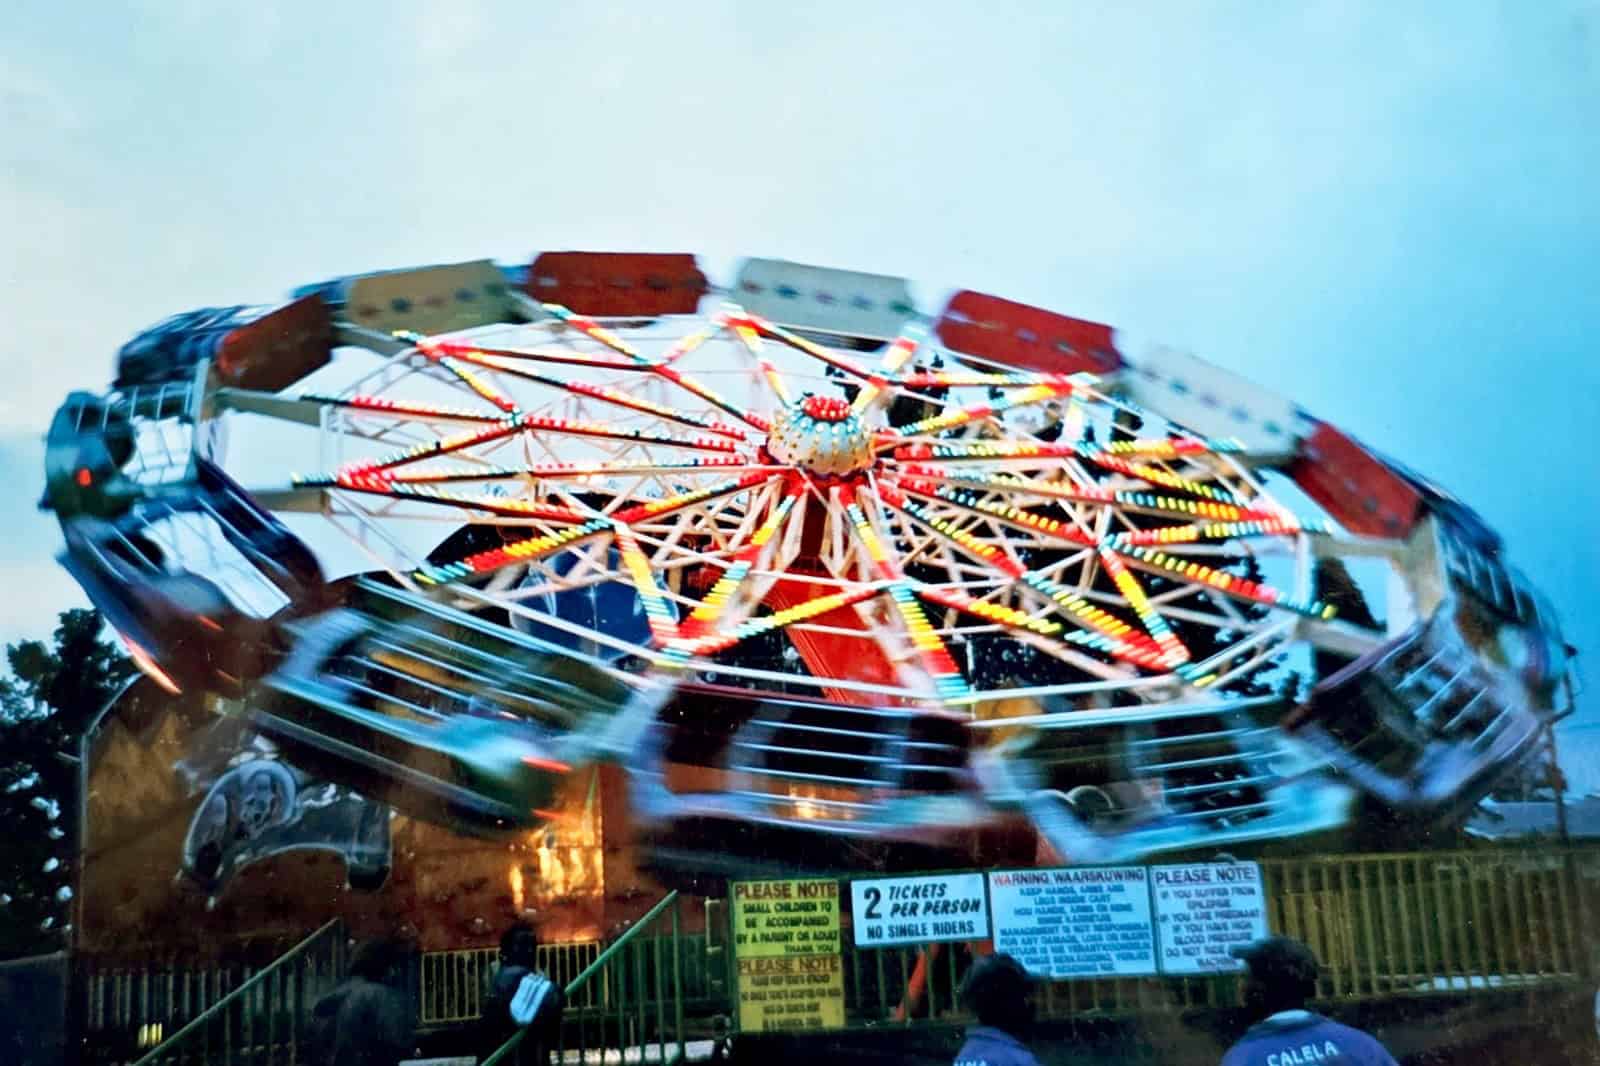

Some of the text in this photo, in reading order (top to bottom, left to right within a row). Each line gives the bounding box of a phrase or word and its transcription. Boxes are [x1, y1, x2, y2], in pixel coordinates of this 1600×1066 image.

[995, 869, 1144, 885] WARNING WAARSKUWING
[1155, 870, 1210, 884] PLEASE
[736, 882, 837, 899] PLEASE NOTE
[888, 883, 947, 900] TICKETS
[1173, 889, 1192, 898] YOU
[1195, 888, 1229, 897] SUFFER
[1232, 887, 1255, 896] FROM
[743, 902, 832, 913] SMALL CHILDREN TO
[864, 887, 882, 919] 2
[889, 898, 981, 917] PER PERSON
[1173, 913, 1191, 922] YOU
[866, 920, 975, 939] NO SINGLE RIDERS
[1000, 926, 1058, 936] MANAGEMENT
[1073, 924, 1090, 933] NOT
[1184, 924, 1203, 932] YOU
[1000, 937, 1018, 945] FOR
[1021, 936, 1038, 945] ANY
[1174, 935, 1205, 945] BLOOD
[816, 943, 834, 952] YOU
[1166, 948, 1180, 957] DO
[1182, 947, 1200, 956] NOT
[736, 959, 795, 973] PLEASE
